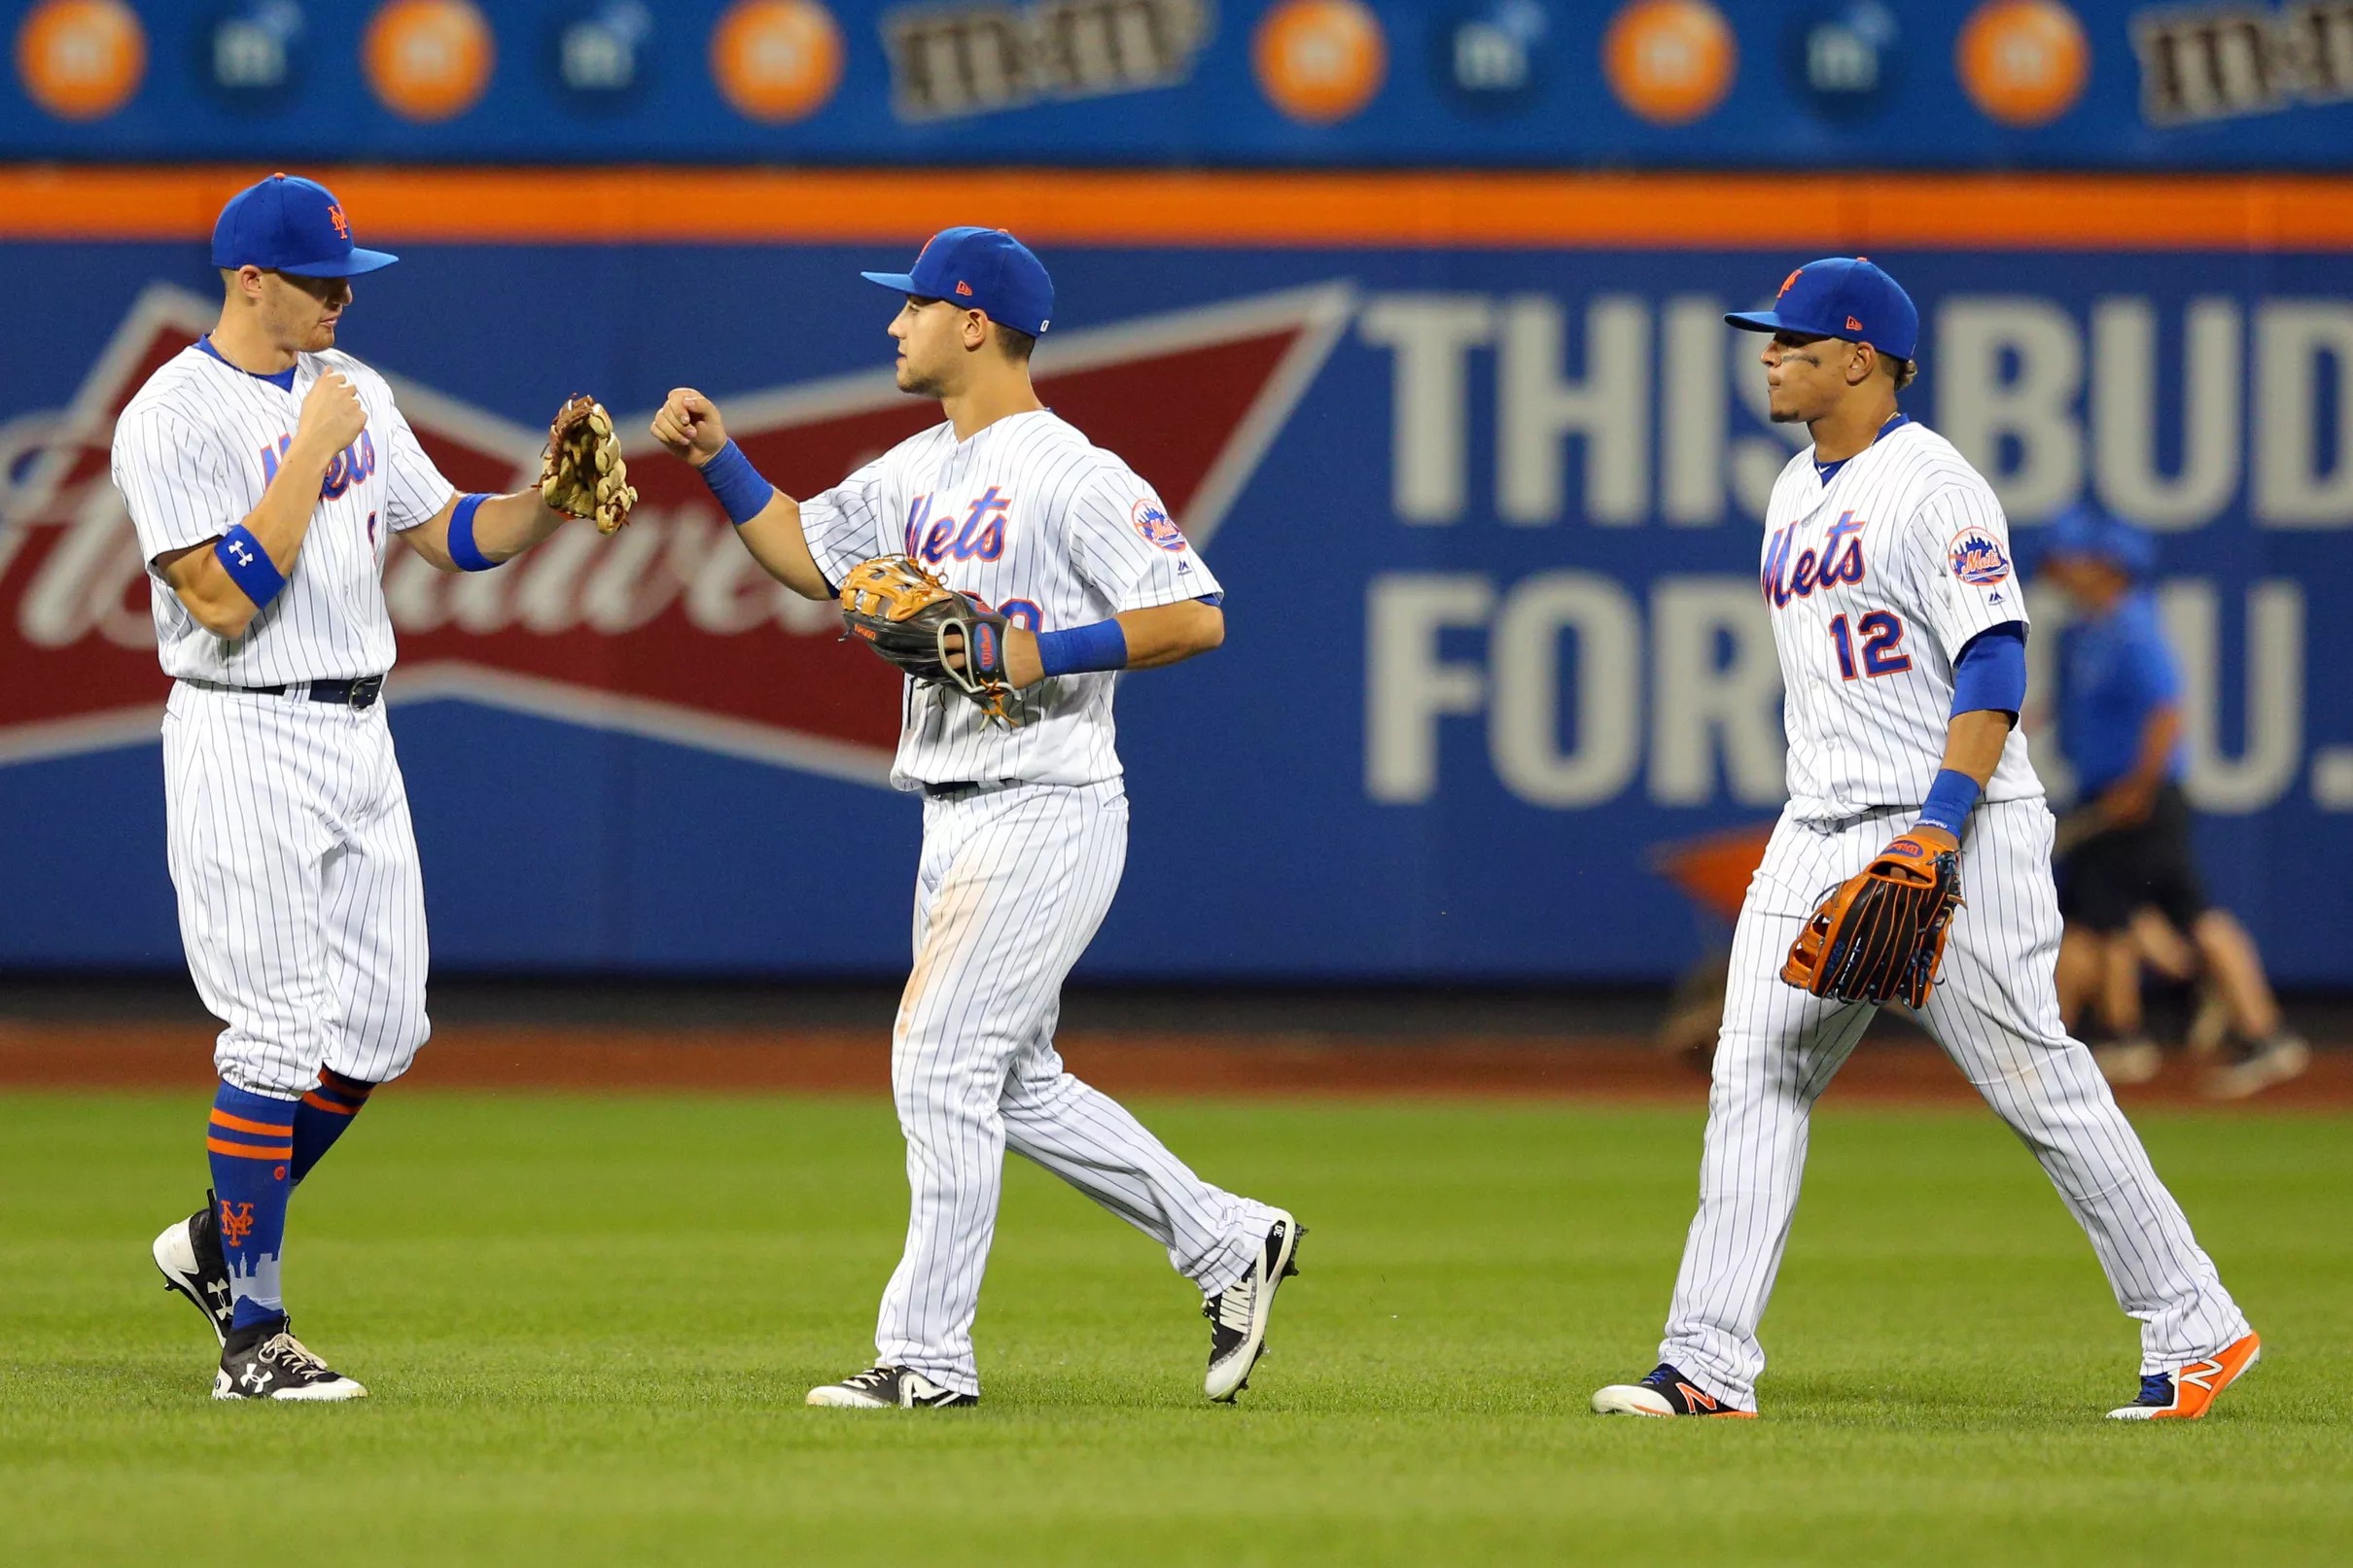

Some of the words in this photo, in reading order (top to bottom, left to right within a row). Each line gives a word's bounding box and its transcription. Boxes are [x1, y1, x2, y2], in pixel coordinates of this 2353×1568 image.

[1935, 297, 2353, 533] BUD
[1961, 548, 2002, 575] Mets
[1828, 610, 1914, 681] 12
[1363, 572, 1791, 810] FOR
[1273, 1225, 1284, 1237] 30
[1218, 1276, 1252, 1334] NIKE
